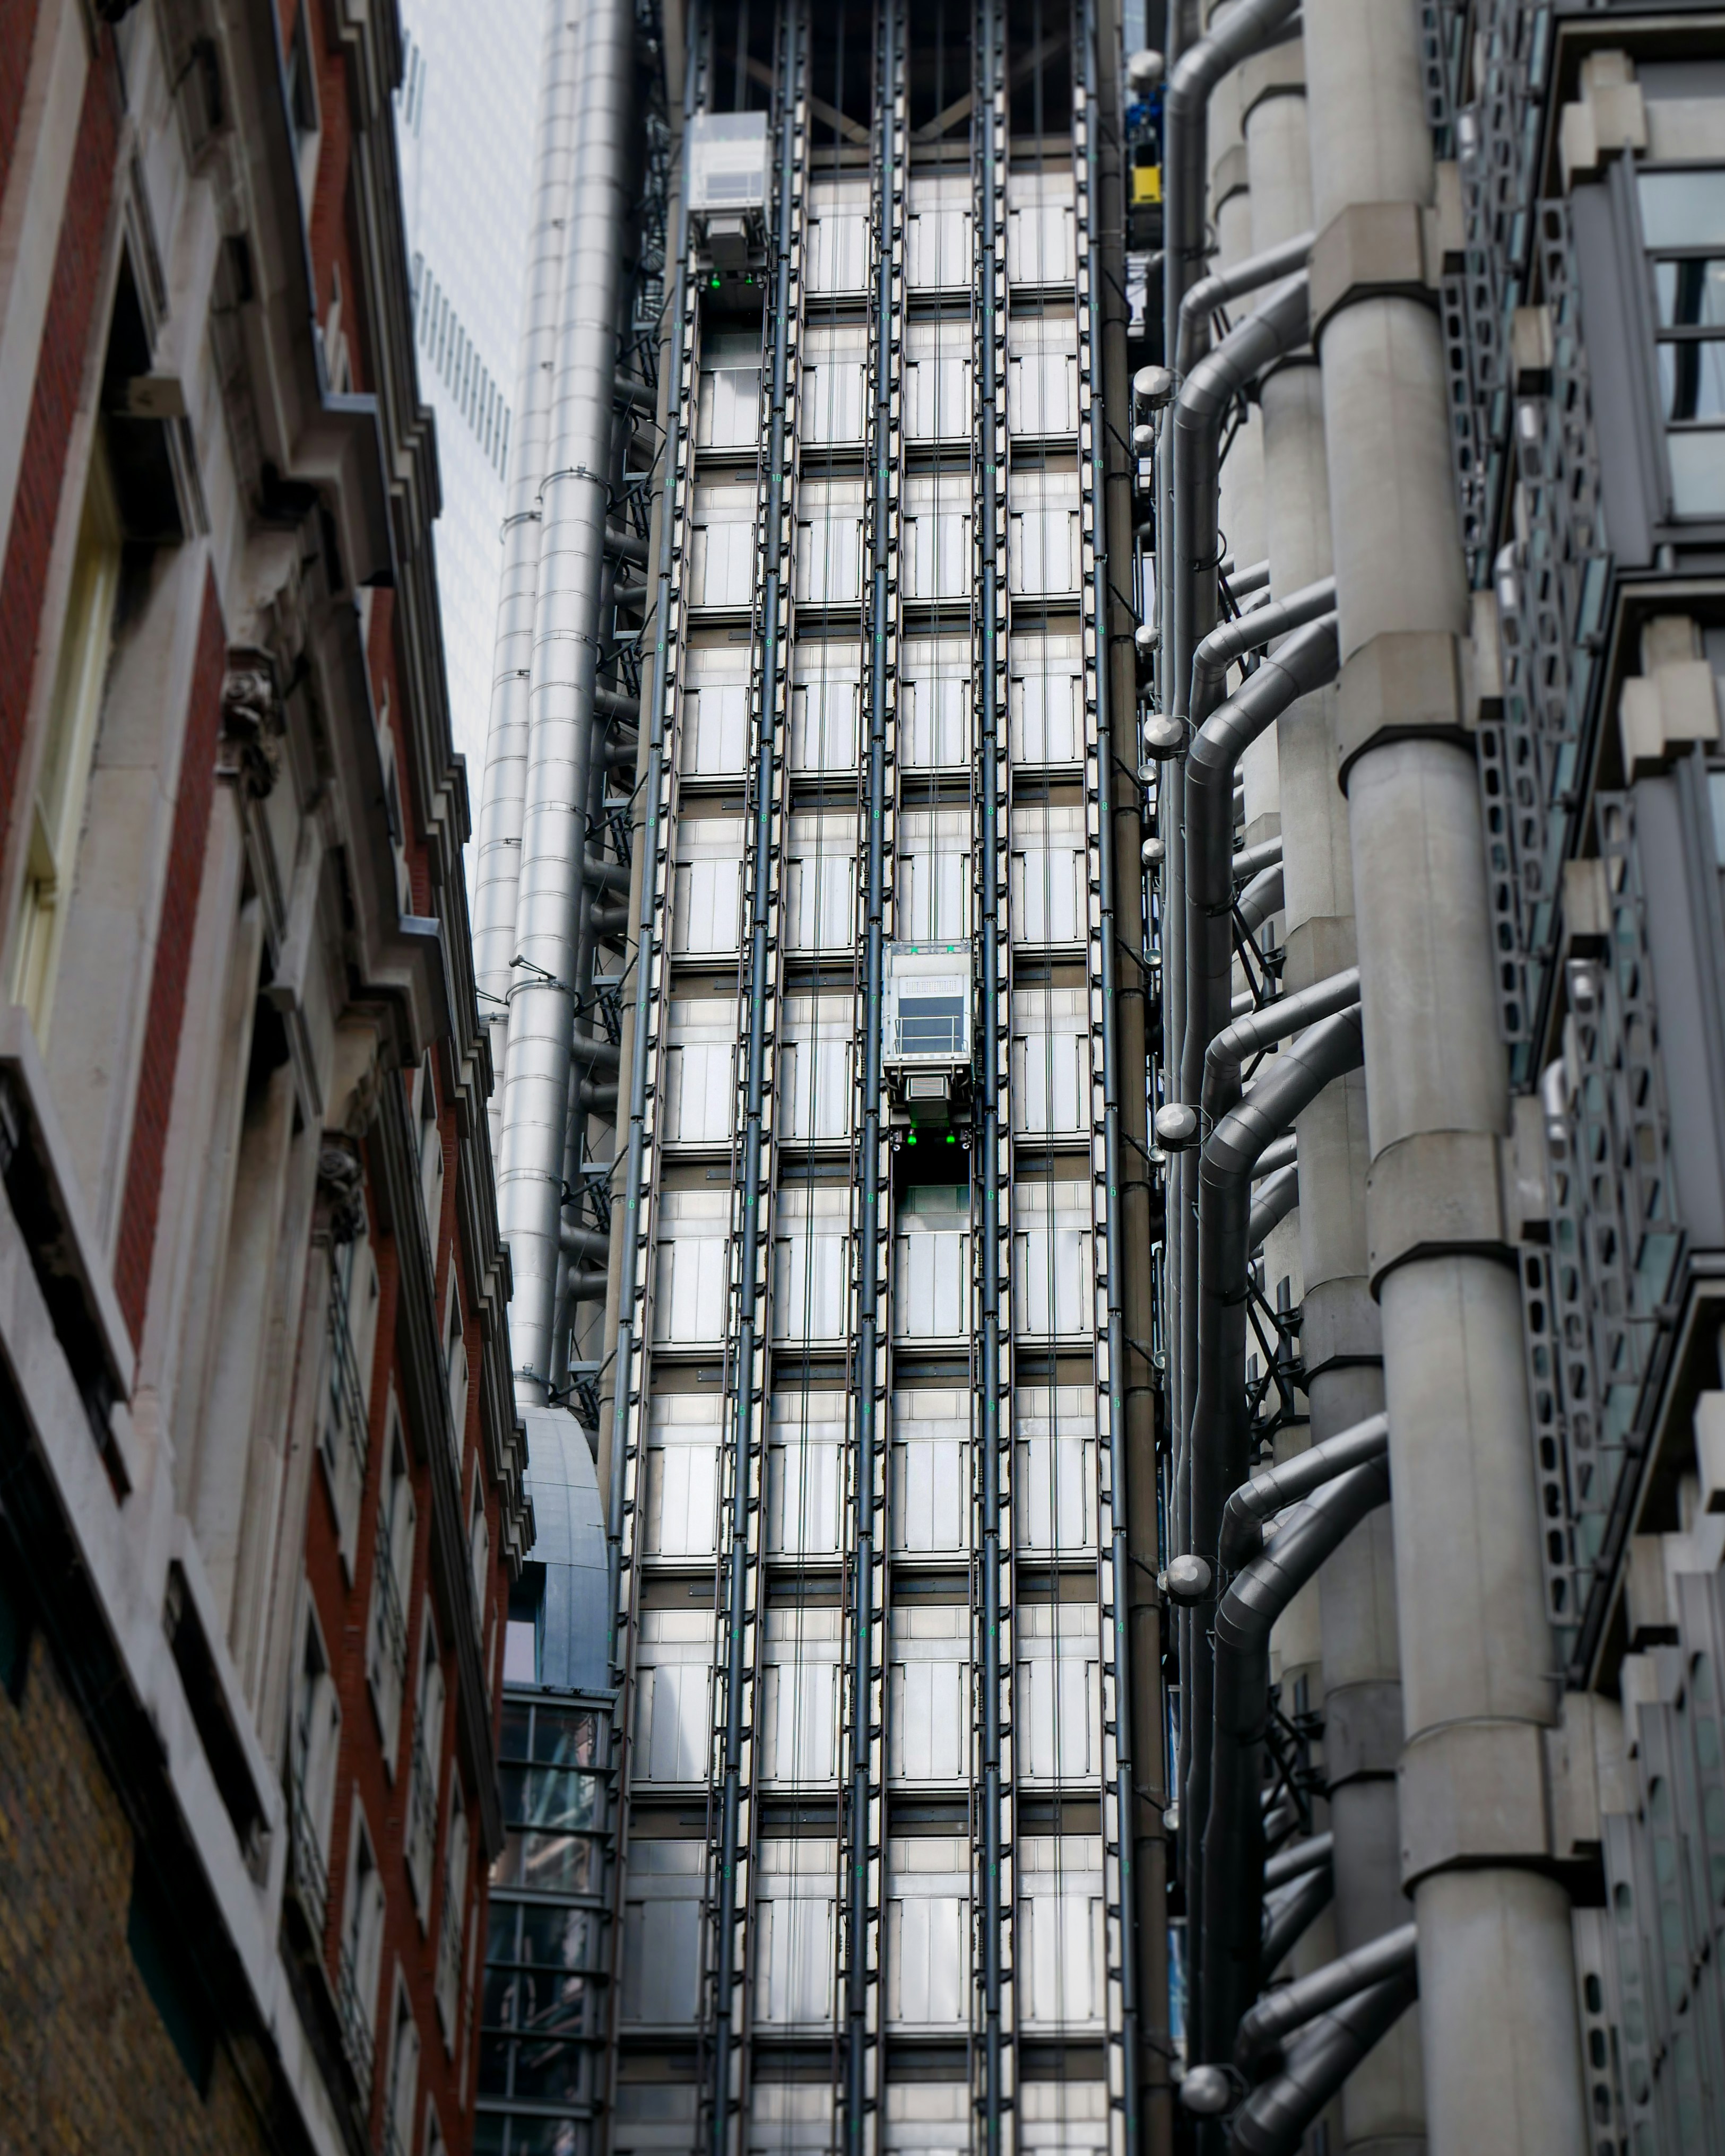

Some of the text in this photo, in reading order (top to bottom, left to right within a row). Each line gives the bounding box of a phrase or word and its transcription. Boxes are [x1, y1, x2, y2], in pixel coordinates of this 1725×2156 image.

[986, 465, 996, 474] 10
[1094, 460, 1103, 469] 10
[772, 474, 782, 482] 10
[879, 469, 889, 478] 10
[666, 478, 675, 487] 10
[987, 629, 993, 639] 9
[1098, 625, 1105, 634] 9
[766, 638, 772, 647] 9
[875, 634, 882, 643] 9
[658, 642, 664, 651] 9
[987, 806, 994, 816] 8
[1101, 802, 1107, 811] 8
[761, 814, 767, 823] 8
[873, 810, 879, 820] 8
[649, 818, 655, 827] 8
[988, 993, 993, 1002] 7
[1107, 988, 1112, 997] 7
[754, 998, 760, 1009] 7
[871, 995, 877, 1005] 7
[640, 1002, 646, 1012] 7
[987, 1190, 994, 1200] 6
[1111, 1186, 1117, 1197] 6
[747, 1196, 753, 1206] 6
[868, 1193, 874, 1203] 6
[629, 1199, 635, 1209] 6
[989, 1401, 995, 1411] 5
[1114, 1397, 1120, 1409] 5
[617, 1409, 623, 1419] 5
[739, 1405, 746, 1416] 5
[863, 1404, 870, 1414] 5
[989, 1625, 995, 1636] 4
[1117, 1622, 1124, 1632] 4
[732, 1629, 739, 1639] 4
[860, 1628, 866, 1637] 4
[724, 1866, 731, 1878] 3
[856, 1866, 863, 1877] 3
